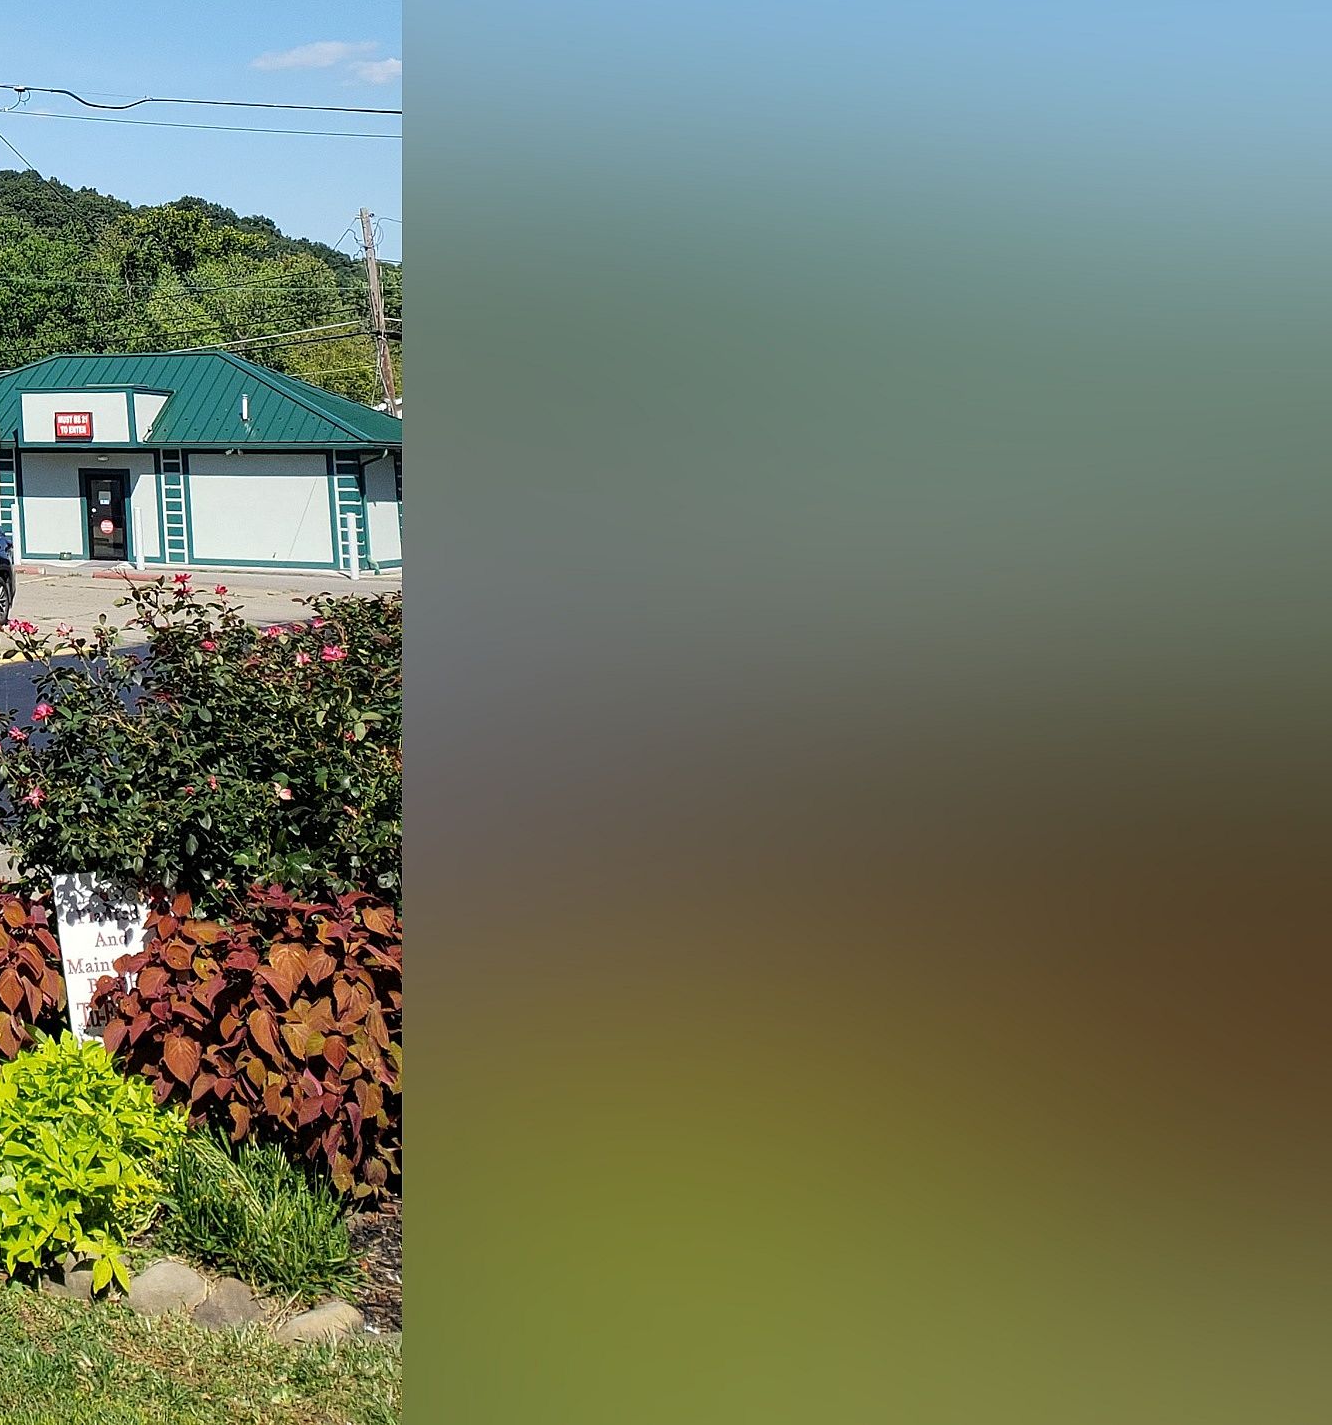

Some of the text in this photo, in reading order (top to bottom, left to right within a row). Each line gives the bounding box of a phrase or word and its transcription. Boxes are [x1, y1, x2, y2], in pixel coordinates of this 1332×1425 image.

[57, 415, 73, 424] MUST
[60, 425, 87, 434] TO ENTER
